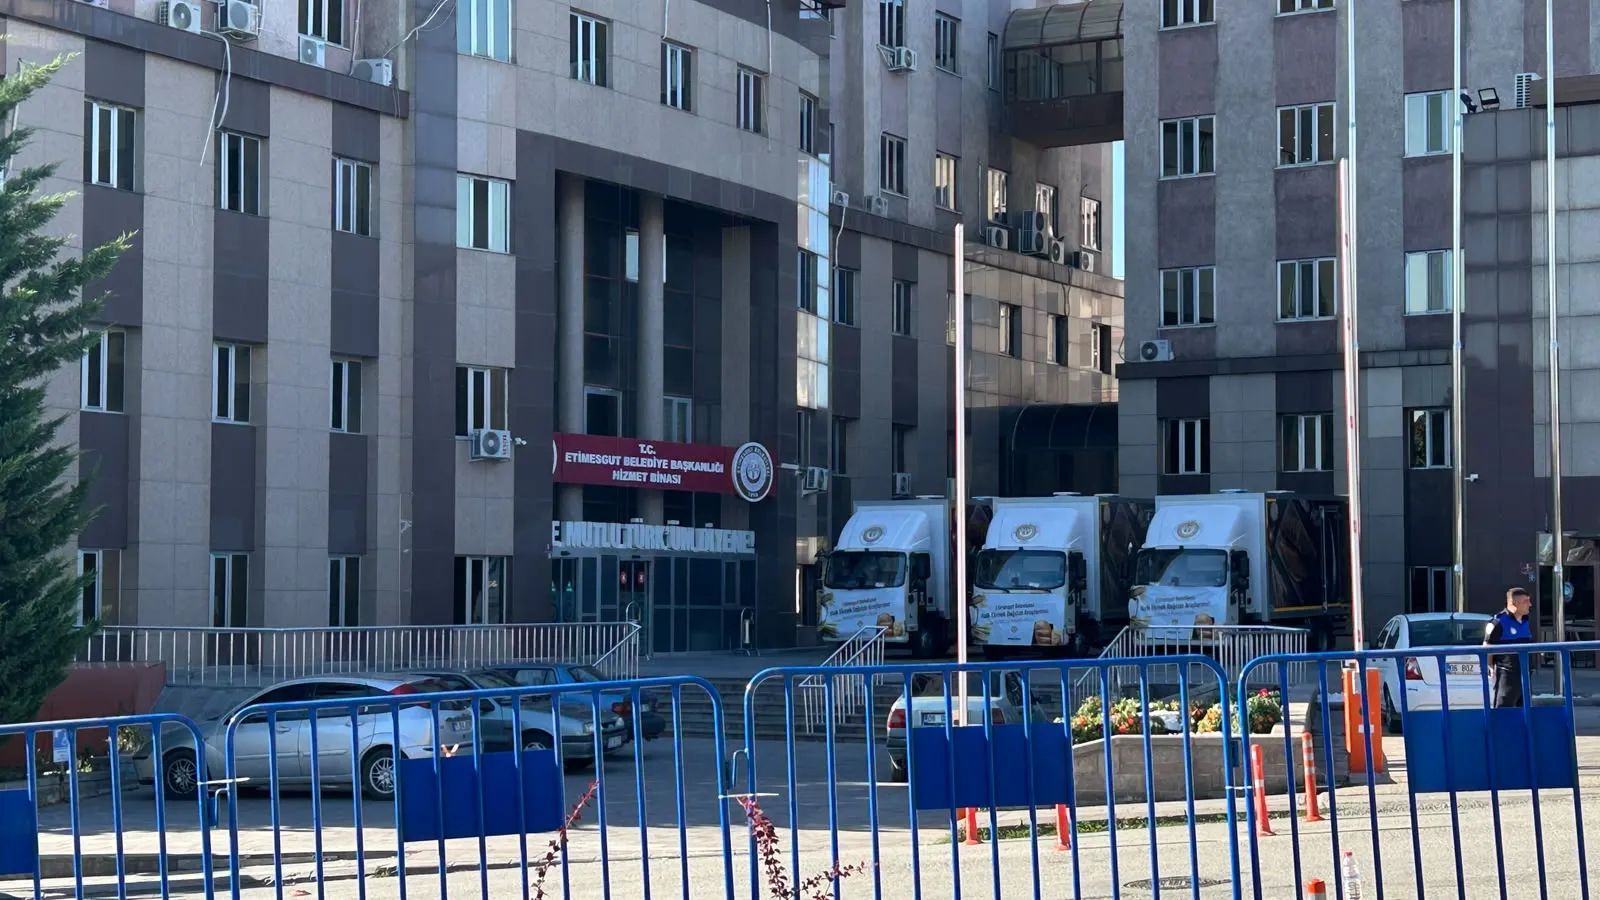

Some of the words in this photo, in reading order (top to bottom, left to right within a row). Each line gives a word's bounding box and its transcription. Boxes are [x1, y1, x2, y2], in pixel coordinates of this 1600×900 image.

[638, 443, 657, 455] T.C.
[565, 451, 621, 466] ETİMESGUT
[624, 456, 668, 469] BELEDİYE
[671, 460, 725, 473] BAŞKANLIĞI
[612, 468, 649, 481] HİZMET
[650, 471, 681, 484] BİNASI
